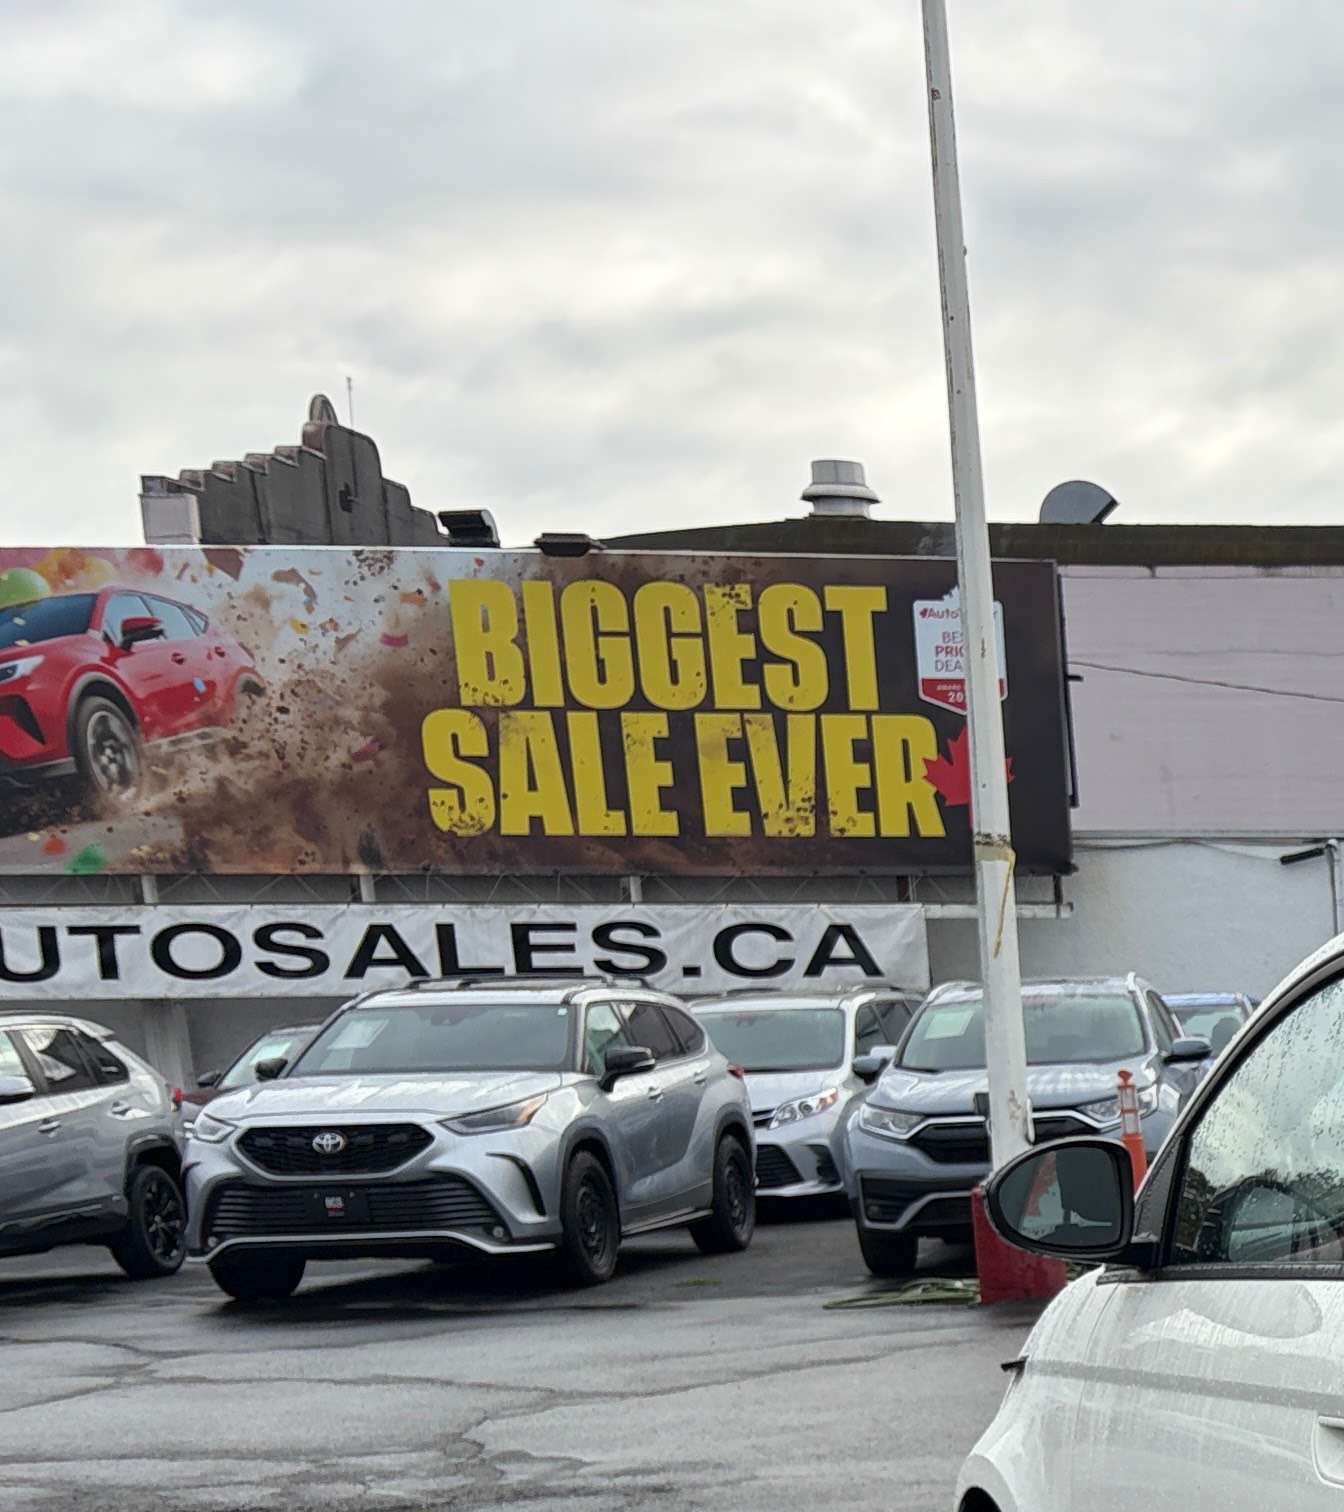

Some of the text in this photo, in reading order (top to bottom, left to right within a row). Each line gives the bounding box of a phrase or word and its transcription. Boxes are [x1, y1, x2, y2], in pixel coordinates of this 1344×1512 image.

[448, 578, 888, 712] BIGGEST
[421, 707, 947, 838] SALE EVER
[0, 921, 885, 983] UTOSALES.CA
